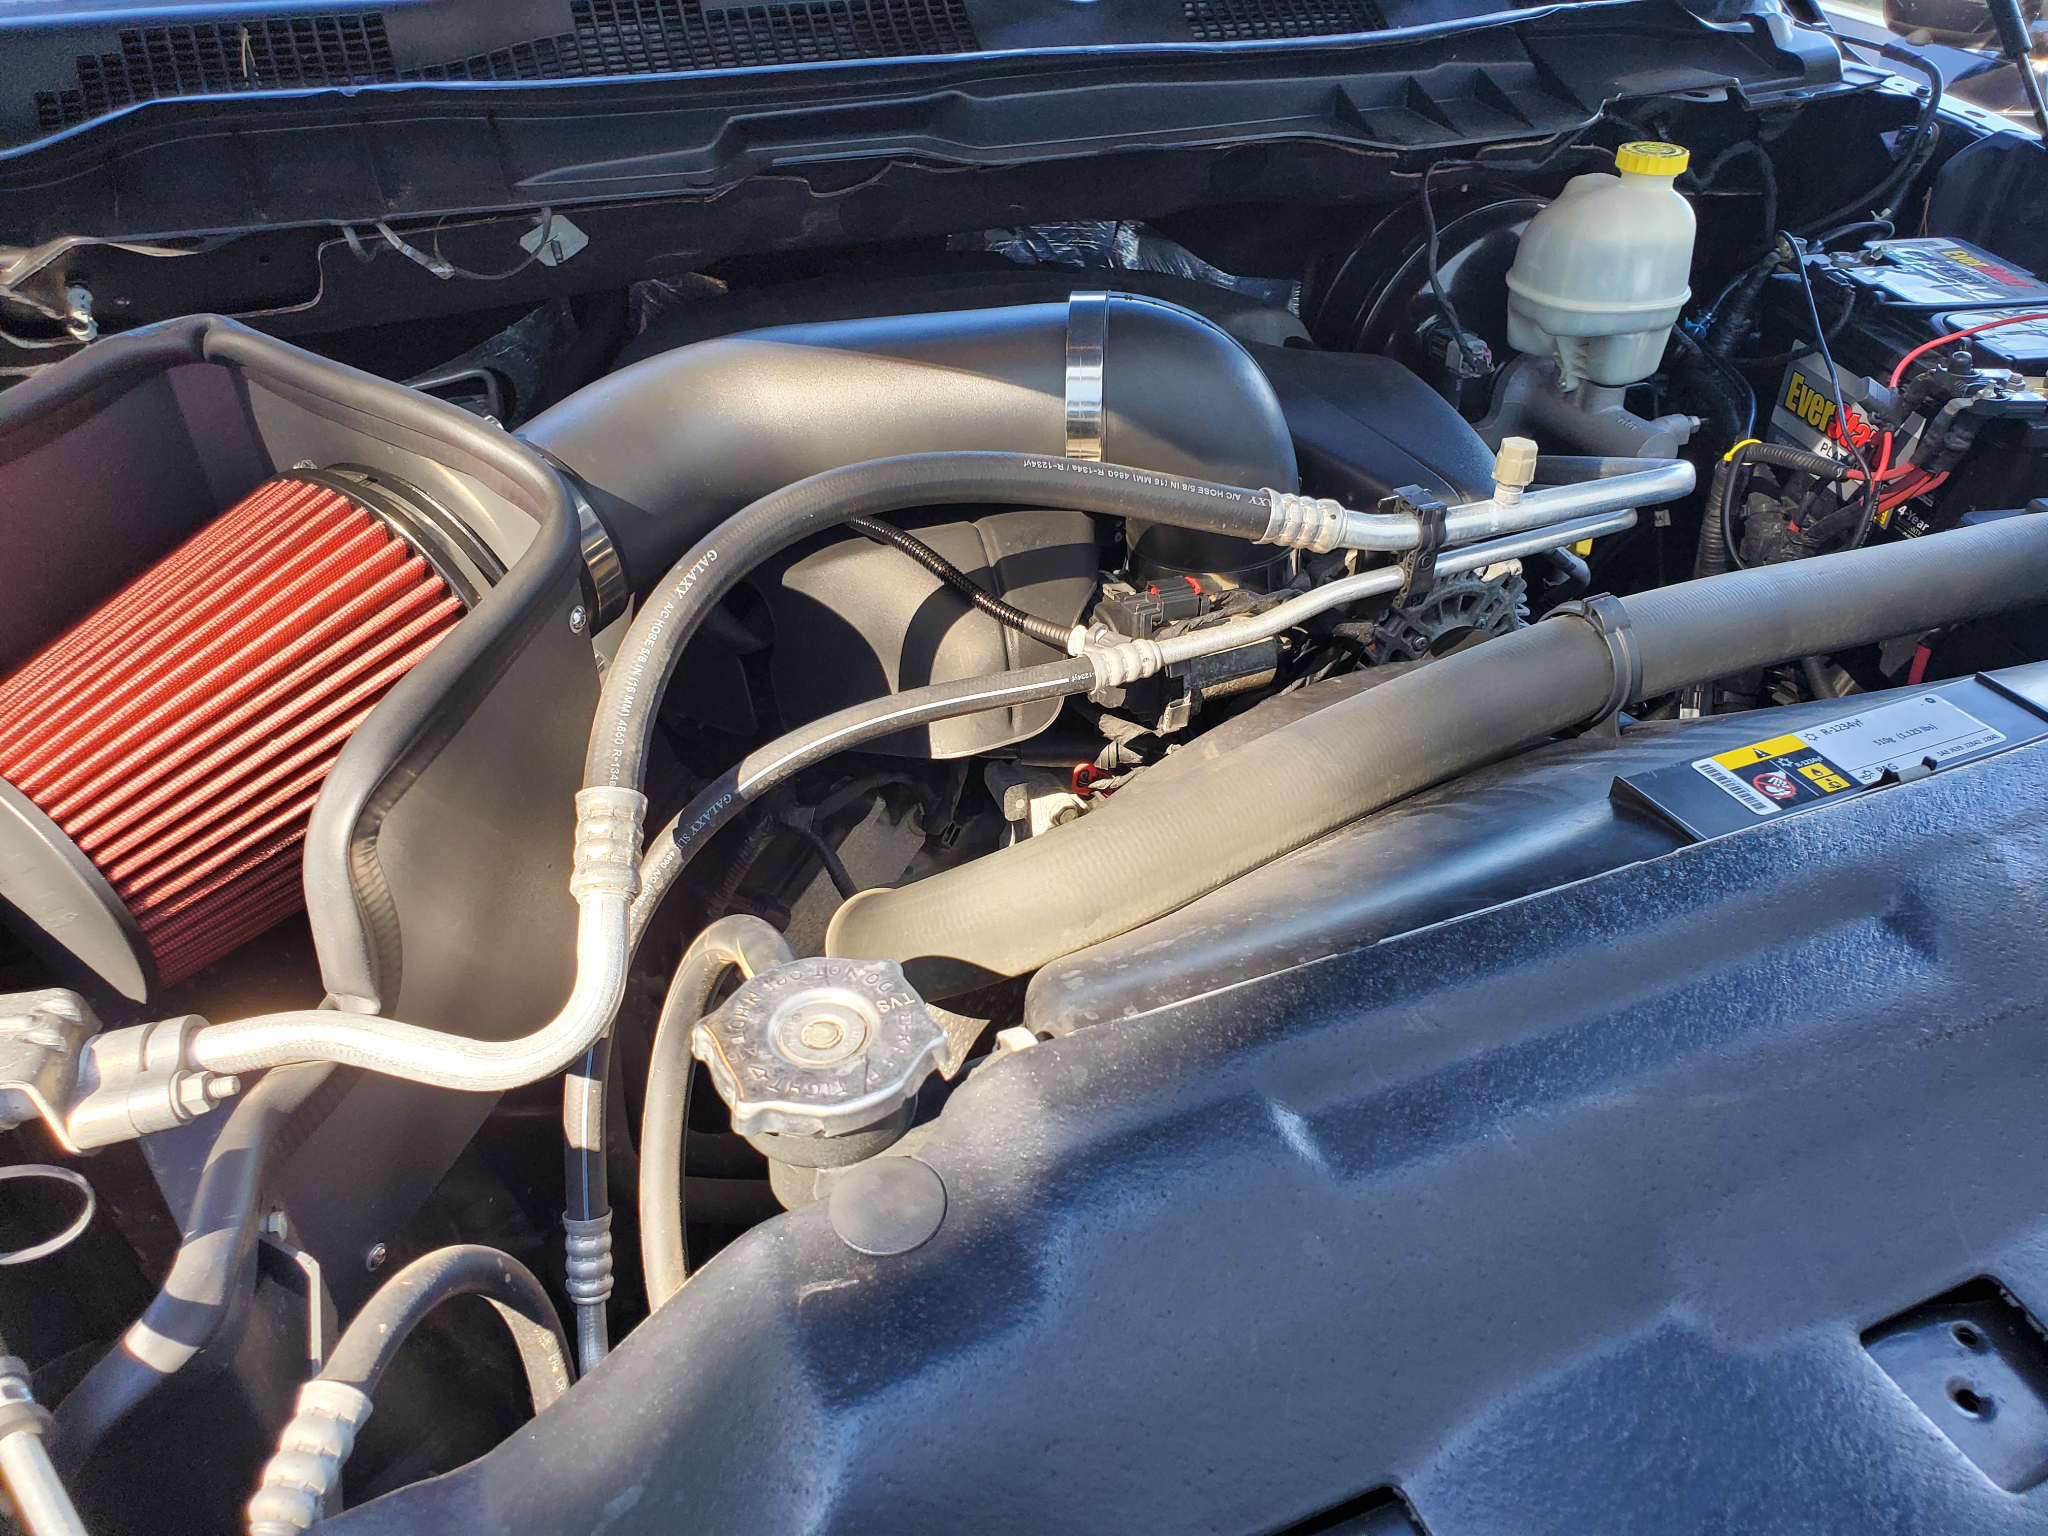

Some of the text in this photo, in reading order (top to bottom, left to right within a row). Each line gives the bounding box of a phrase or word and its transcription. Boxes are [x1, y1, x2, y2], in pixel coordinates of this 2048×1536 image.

[1023, 459, 1064, 471] R-1234yf
[1071, 465, 1105, 477] R-134a
[1107, 471, 1130, 480] 4860
[1132, 474, 1152, 485] MM)
[1153, 478, 1168, 488] (16
[1170, 481, 1181, 490] IN
[1182, 483, 1196, 493] 5/8
[1198, 486, 1224, 498] HOSE
[1226, 493, 1242, 502] A/C
[1897, 505, 1930, 532] 4-Year
[609, 549, 718, 787] GALAXY A/C HOSE 5/8 IN (16 MM) 4860 R-134a
[1071, 671, 1095, 683] -1234yf
[1819, 718, 1865, 736] R-1234yf
[1872, 723, 1938, 747] 510g (1.125 lbs)
[689, 793, 733, 837] GALAXY
[660, 850, 676, 869] 4890
[649, 868, 662, 884] A/C
[636, 883, 654, 908] HOSE
[866, 973, 894, 994] DO
[876, 992, 915, 1014] TVS
